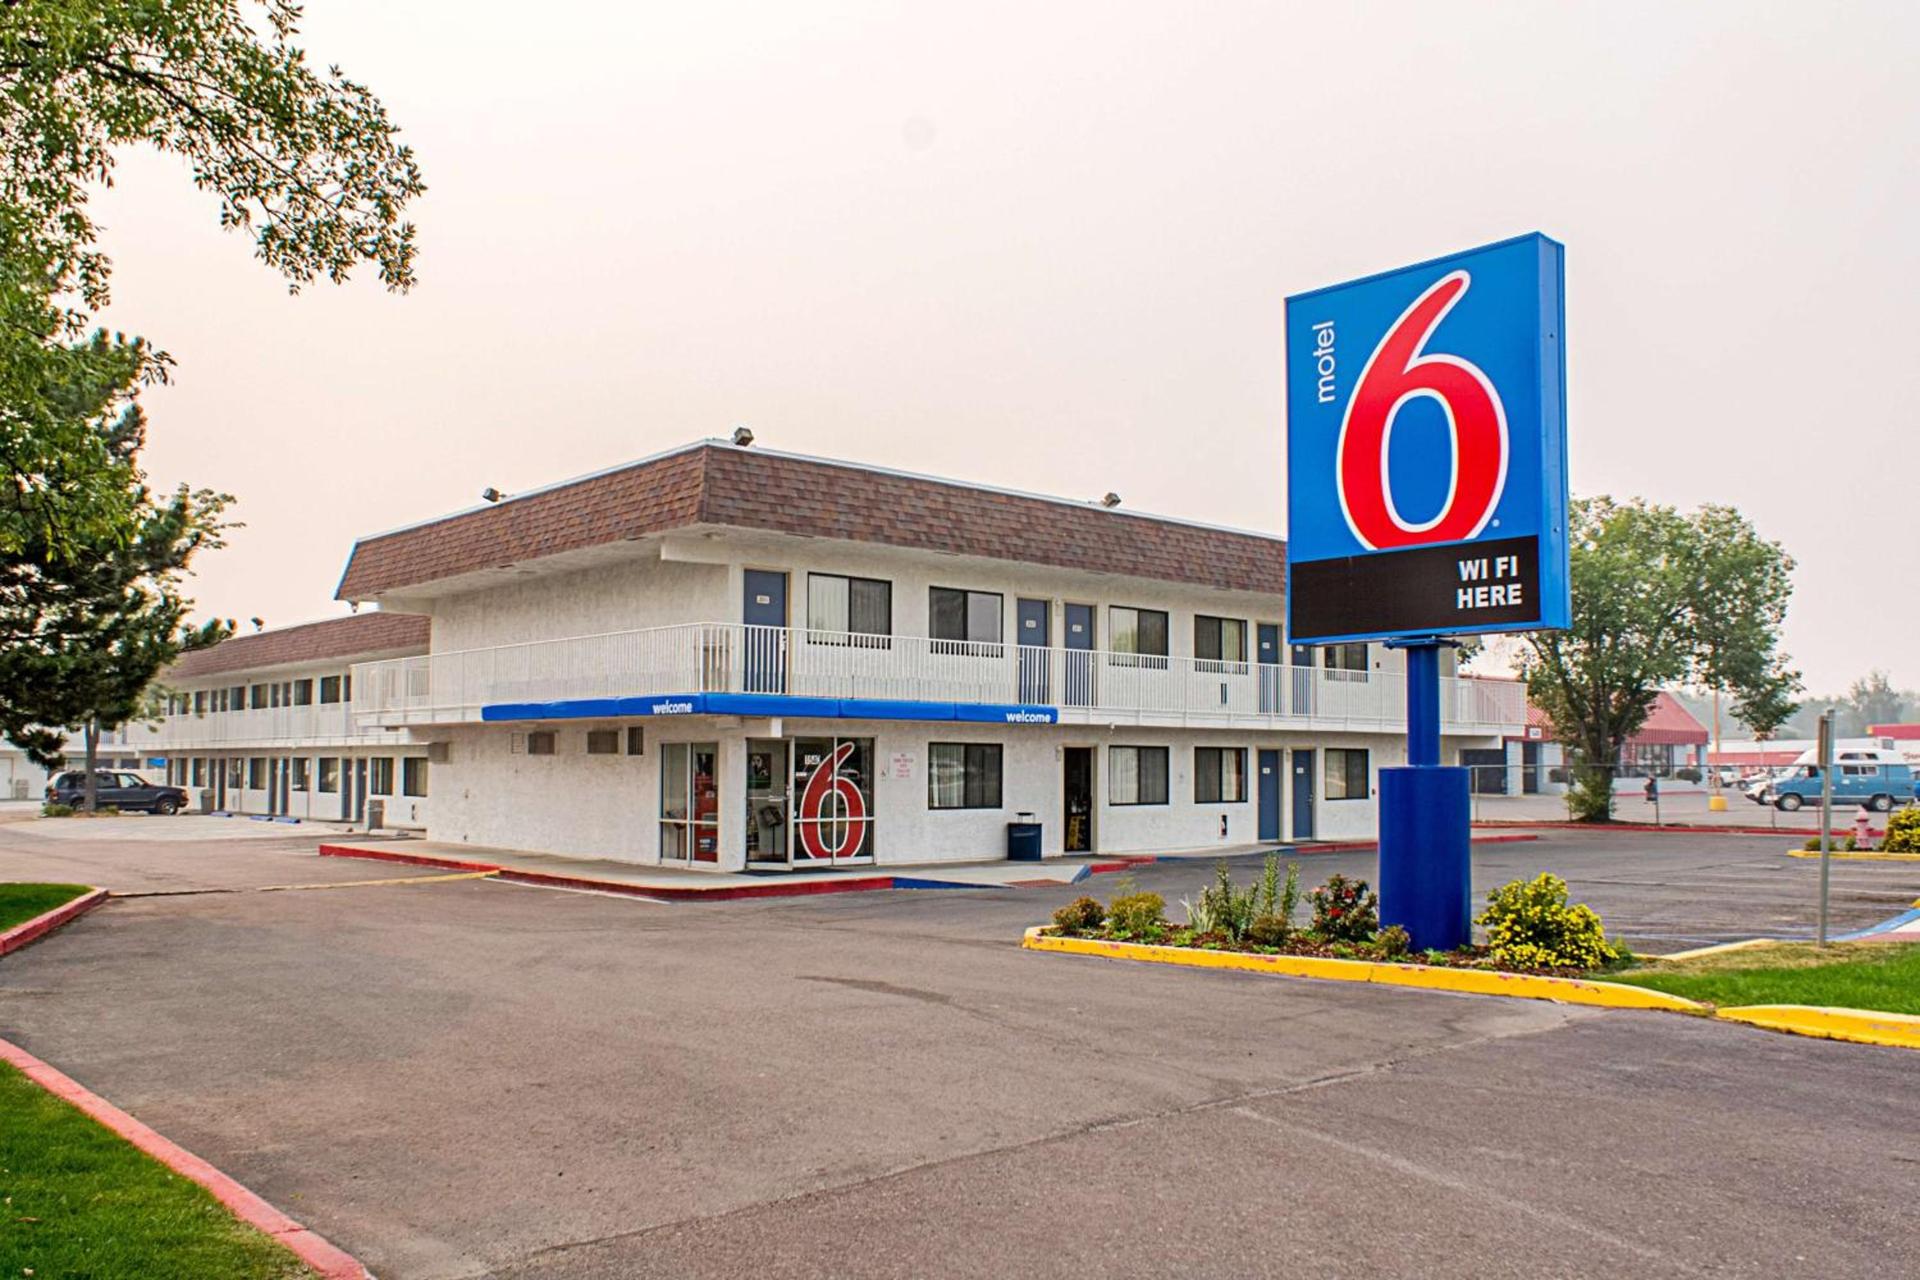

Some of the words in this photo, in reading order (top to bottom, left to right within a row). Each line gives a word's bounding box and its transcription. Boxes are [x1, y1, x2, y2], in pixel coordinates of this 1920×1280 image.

[1312, 321, 1335, 402] motel
[1336, 270, 1510, 550] 6
[1458, 559, 1488, 581] WI
[1495, 555, 1518, 578] FI
[1457, 583, 1522, 609] HERE
[652, 699, 693, 715] welcome
[1005, 709, 1052, 723] welcome
[800, 741, 866, 859] 6
